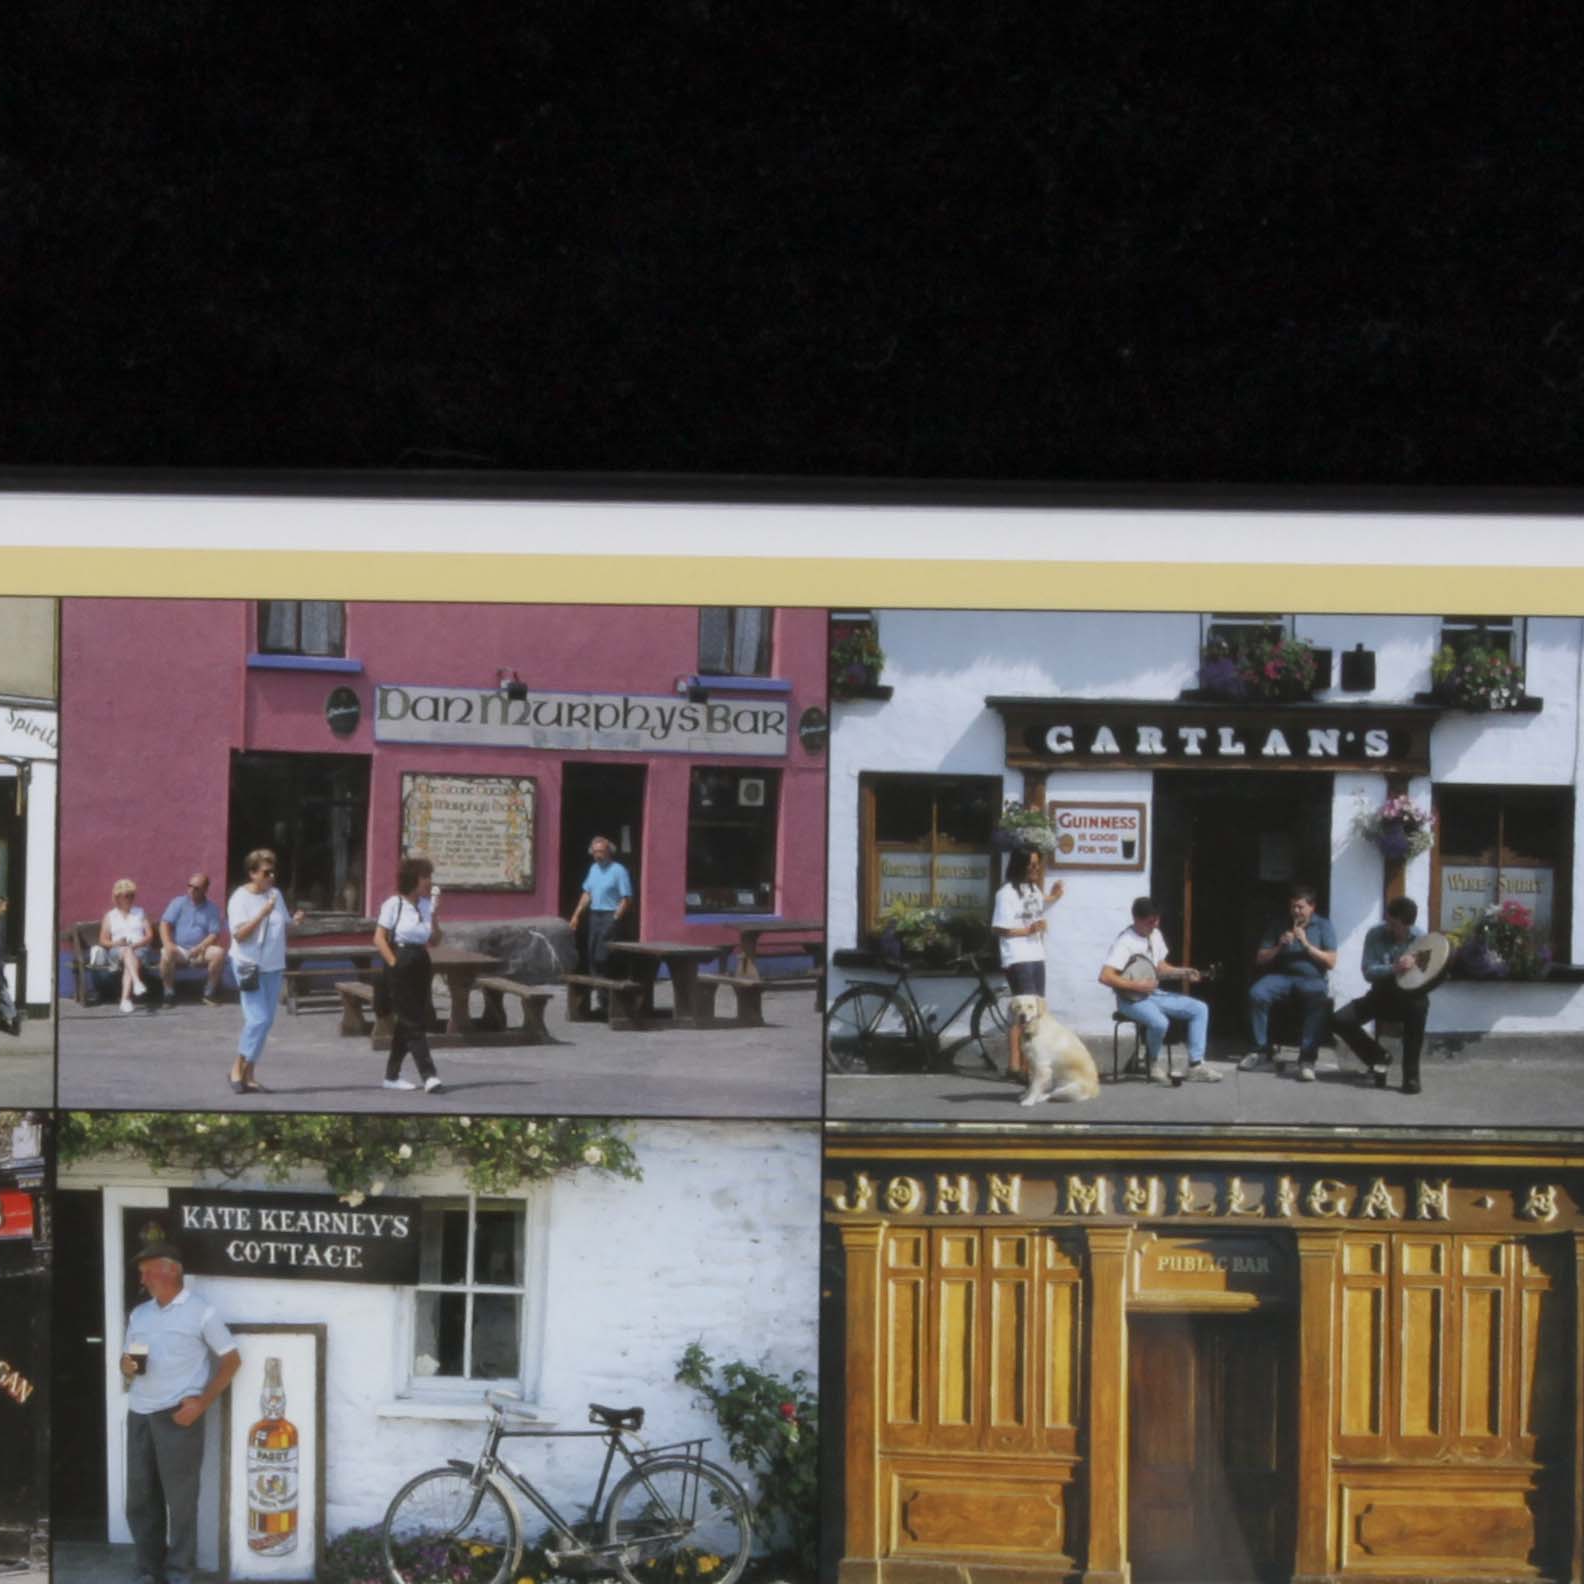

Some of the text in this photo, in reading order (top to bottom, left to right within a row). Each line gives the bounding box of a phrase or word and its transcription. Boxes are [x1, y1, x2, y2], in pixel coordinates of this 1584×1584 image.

[1058, 813, 1136, 829] GUINNESS
[830, 1171, 1022, 1215] JOHN
[1065, 1176, 1450, 1221] MULLIGAN
[182, 1206, 410, 1238] KATE KEARNEY'S
[226, 1241, 363, 1268] COTTAGE
[1157, 1256, 1270, 1272] PUBLIC BAR
